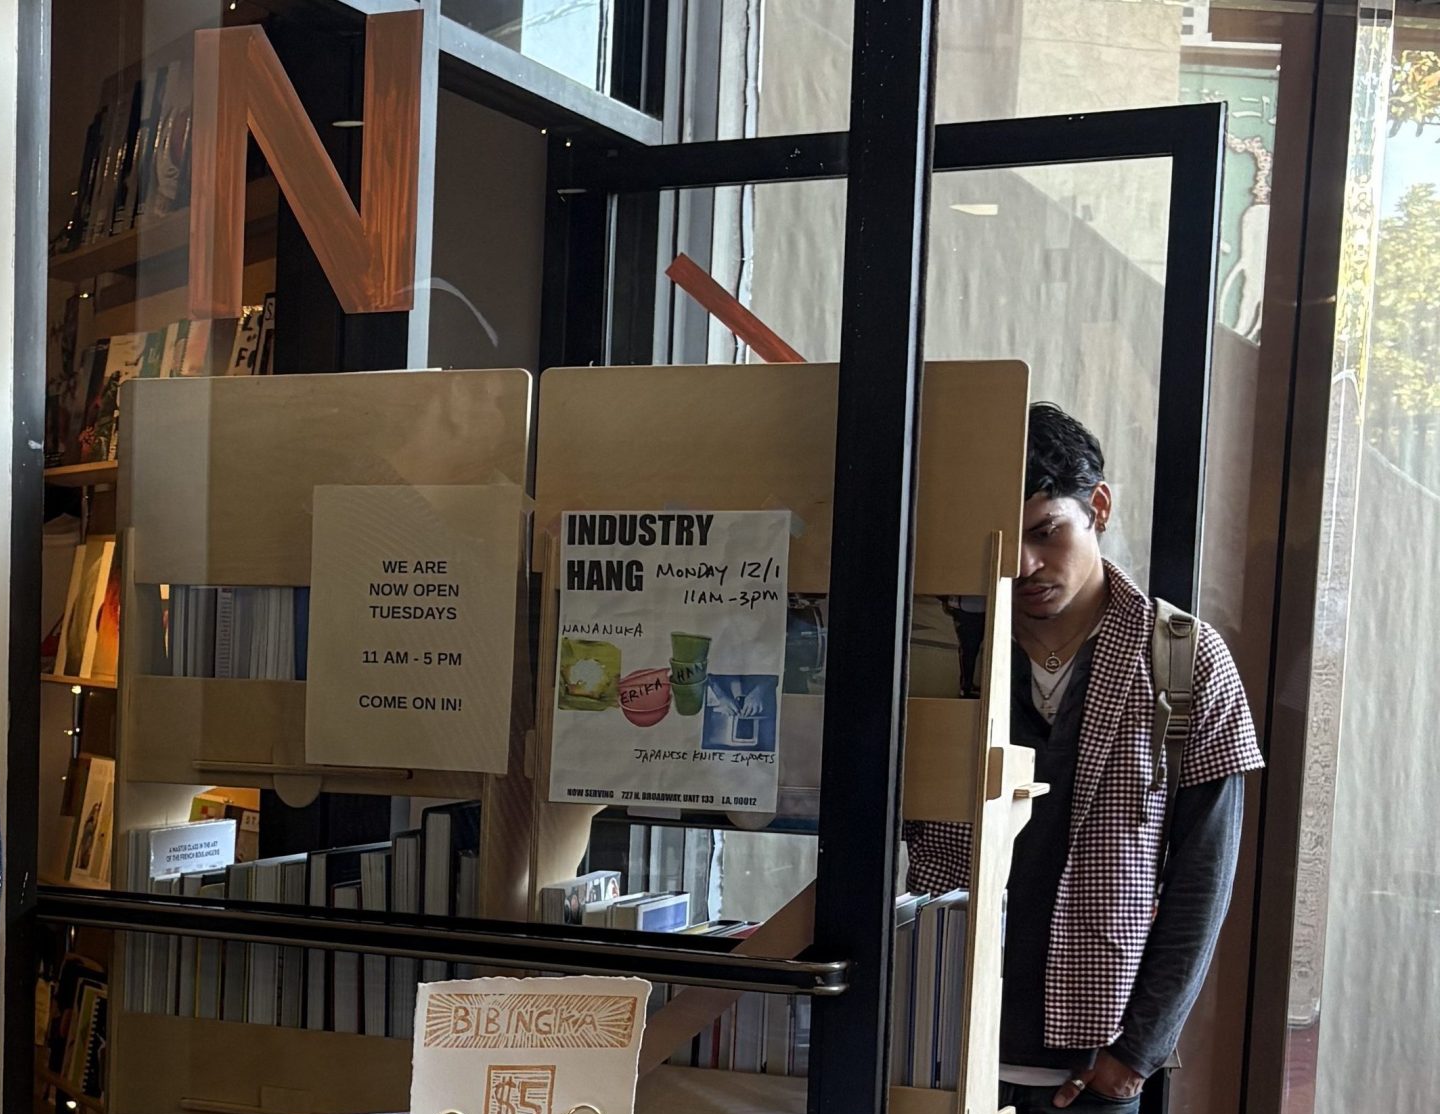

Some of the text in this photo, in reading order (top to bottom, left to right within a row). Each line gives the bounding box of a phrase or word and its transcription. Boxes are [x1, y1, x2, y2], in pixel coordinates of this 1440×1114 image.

[188, 9, 423, 319] N
[567, 514, 714, 546] INDUSTRY
[382, 560, 448, 574] WE ARE
[740, 557, 779, 582] 12/1
[567, 560, 644, 591] HANG
[369, 583, 460, 597] NOW OPEN
[369, 605, 457, 620] TUESDAYS
[562, 622, 644, 637] NANANUKA
[362, 650, 378, 664] 11
[384, 651, 408, 664] AM
[423, 652, 433, 665] 5
[437, 652, 462, 666] PM
[359, 694, 462, 712] COME ON IN!
[634, 748, 688, 763] JAPANESE
[567, 788, 584, 797] NOW
[584, 789, 614, 798] SERVING
[621, 791, 634, 800] 727
[682, 793, 700, 803] UNIT
[451, 1004, 599, 1037] BIBINGKA
